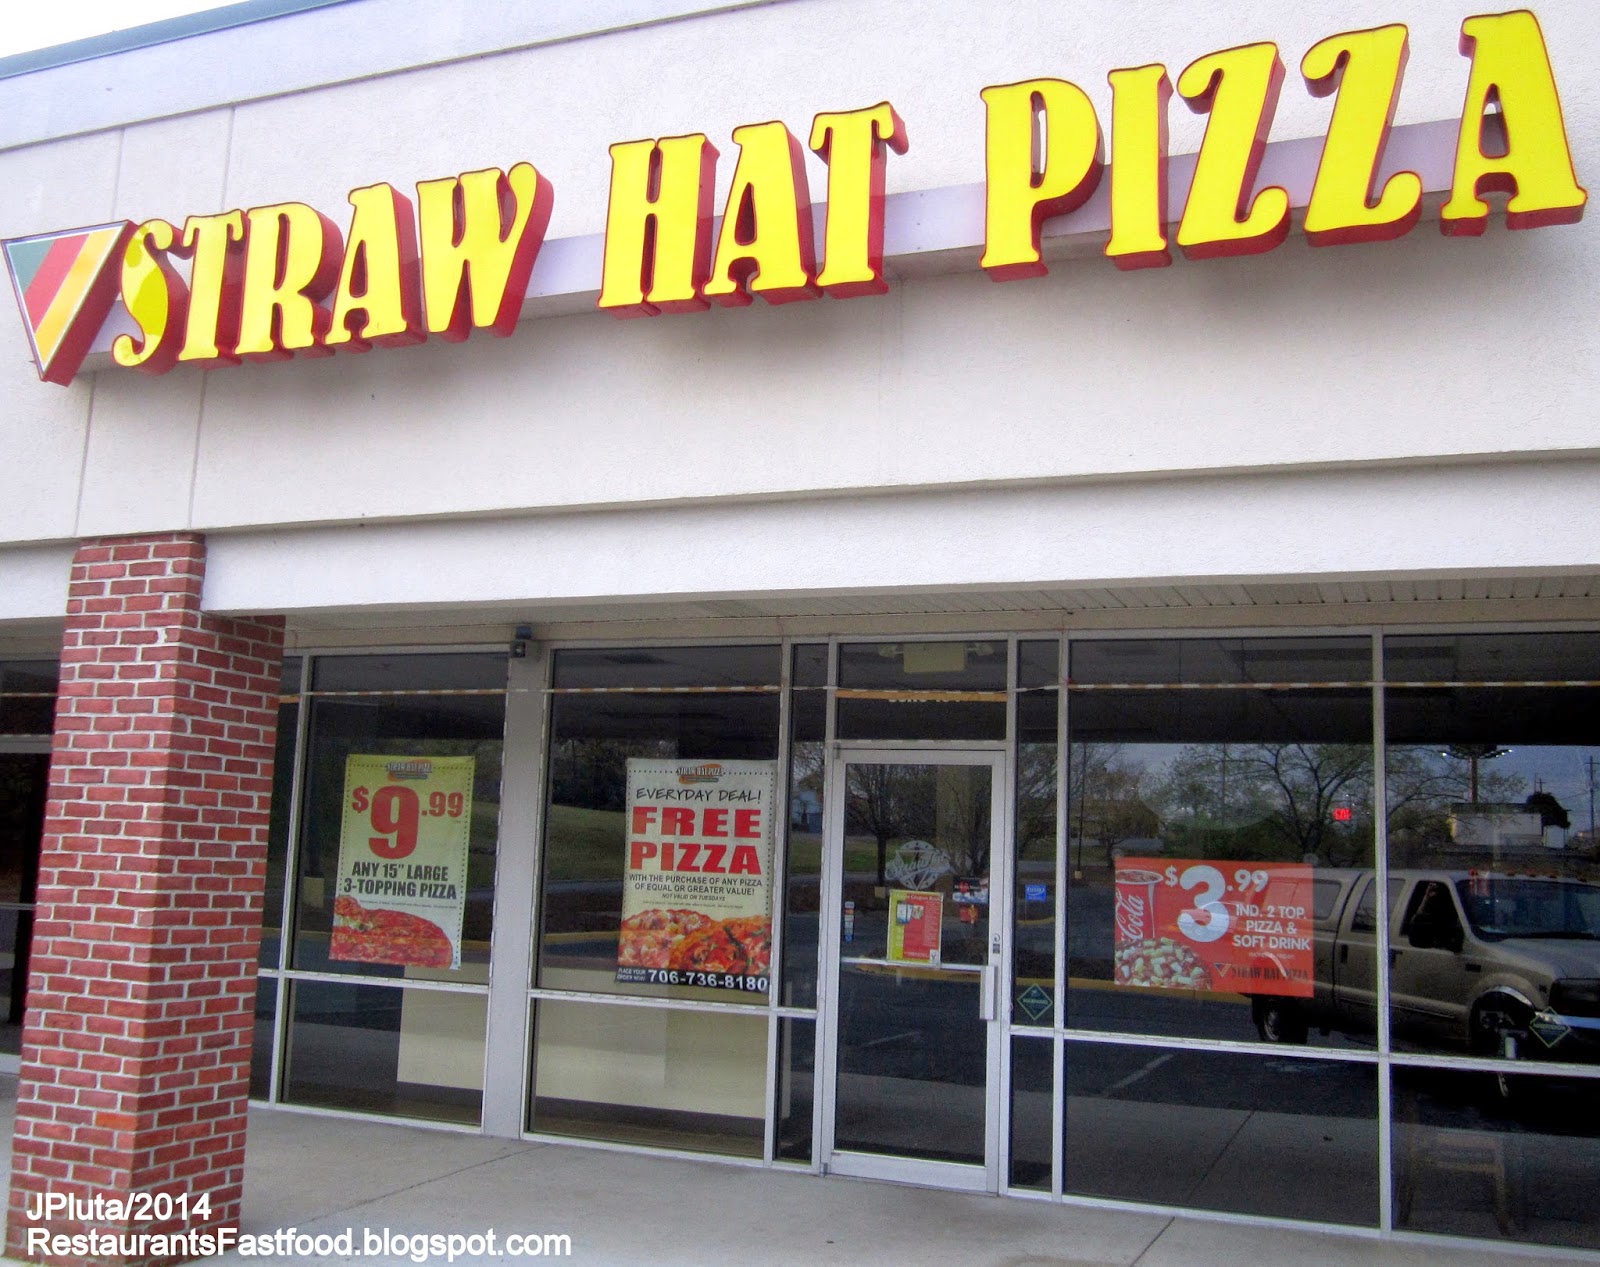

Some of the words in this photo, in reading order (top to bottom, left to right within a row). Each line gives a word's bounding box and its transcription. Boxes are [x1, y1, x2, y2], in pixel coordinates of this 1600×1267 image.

[112, 161, 550, 370] STRAW
[597, 101, 903, 312] HAT
[980, 9, 1587, 274] PIZZA
[636, 788, 713, 801] EVERYDAY
[719, 789, 762, 804] DEAL!
[352, 785, 464, 859] $9.99
[632, 806, 762, 839] FREE
[629, 842, 762, 875] PIZZA
[352, 861, 379, 876] ANY
[406, 864, 448, 881] LARGE
[666, 875, 707, 885] PURCHASE
[722, 878, 738, 886] ANY
[740, 879, 762, 887] PIZZA
[344, 878, 416, 897] 3-TOPPING
[419, 883, 457, 900] PIZZA
[646, 883, 672, 892] EQUAL
[687, 885, 724, 894] GREATER
[726, 887, 755, 896] VALUE!
[1165, 865, 1269, 942] $3.99
[1236, 904, 1263, 916] IND.
[1267, 906, 1275, 917] 2
[1279, 906, 1307, 919] TOP.
[1246, 921, 1283, 933] PIZZA
[1286, 922, 1297, 934] &
[1233, 936, 1265, 948] SOFT
[1269, 937, 1311, 950] DRINK
[648, 969, 768, 991] 706-736-8180
